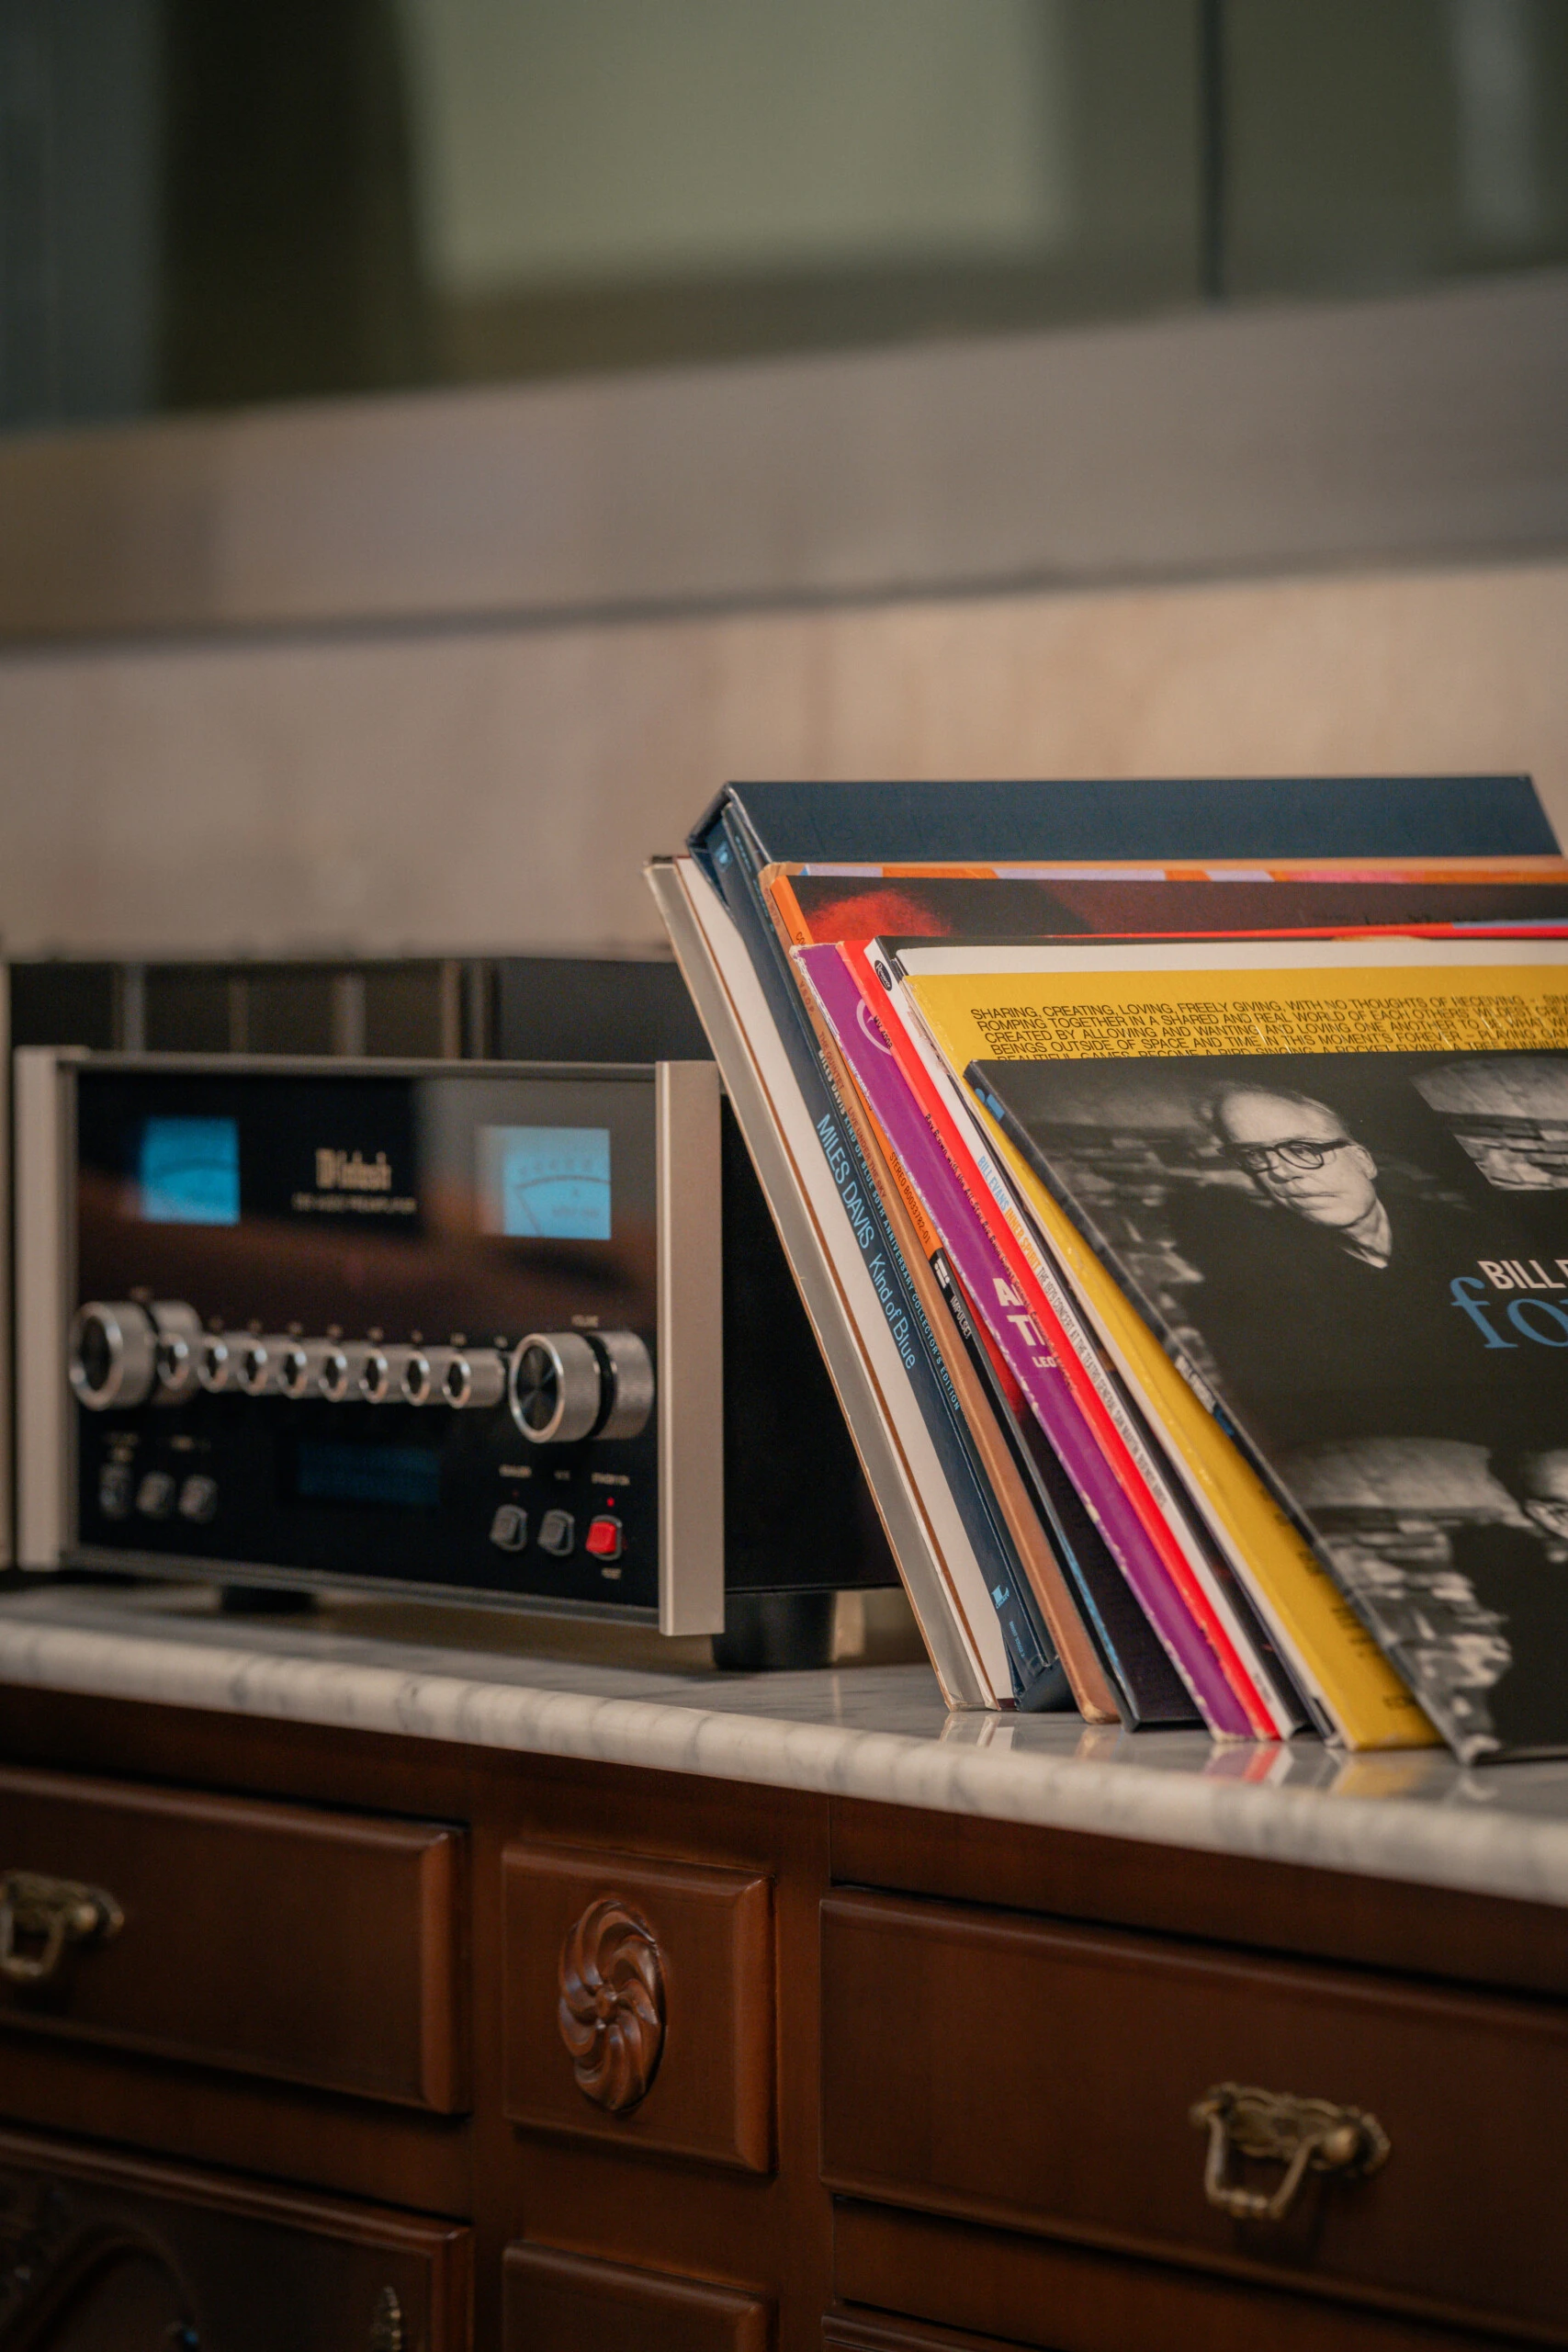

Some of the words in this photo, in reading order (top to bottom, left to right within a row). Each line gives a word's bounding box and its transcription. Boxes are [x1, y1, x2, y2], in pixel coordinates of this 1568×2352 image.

[970, 1007, 1042, 1019] SHARING,
[1043, 1005, 1118, 1016] CREATING,
[1118, 1003, 1178, 1015] LOVING,
[1177, 1002, 1228, 1013] FREELY
[1233, 1001, 1286, 1012] GIVING,
[1285, 1000, 1323, 1011] WITH
[1324, 999, 1348, 1010] NO
[1348, 998, 1427, 1010] THOUGHTS
[1429, 997, 1448, 1008] OF
[976, 1018, 1047, 1031] ROMPING
[1047, 1016, 1128, 1028] TOGETHER
[1129, 1015, 1145, 1026] IN
[1149, 1015, 1159, 1025] A
[1161, 1013, 1218, 1025] SHARED
[1224, 1013, 1252, 1023] AND
[1254, 1012, 1292, 1023] REAL
[1292, 1012, 1345, 1023] WORLD
[1348, 1011, 1367, 1021] OF
[1371, 1010, 1410, 1021] EACH
[985, 1030, 1053, 1043] CREATED
[1055, 1029, 1076, 1040] BY
[1083, 1027, 1158, 1039] ALLOWING
[1162, 1026, 1191, 1036] AND
[1193, 1024, 1260, 1036] WANTING
[1266, 1023, 1294, 1035] AND
[1296, 1023, 1351, 1034] LOVING
[1354, 1022, 1387, 1033] ONE
[1391, 1019, 1457, 1031] ANOTHER
[1458, 1019, 1479, 1029] TO
[990, 1042, 1048, 1055] BEINGS
[1051, 1040, 1114, 1052] OUTSIDE
[1117, 1039, 1136, 1049] OF
[1141, 1037, 1190, 1049] SPACE
[1193, 1036, 1222, 1047] AND
[1224, 1035, 1261, 1047] TIME
[1264, 1035, 1280, 1046] IN
[1281, 1035, 1315, 1046] THIS
[1317, 1033, 1393, 1045] MOMENT'S
[1396, 1030, 1462, 1043] FOREVER
[824, 1050, 844, 1090] QUINTET
[847, 1106, 859, 1126] LIVE
[855, 1128, 872, 1160] UNDER
[869, 1161, 879, 1179] THE
[875, 1179, 887, 1199] SKY
[888, 1151, 907, 1185] STEREO
[924, 1113, 936, 1130] Ray
[932, 1128, 949, 1154] Brown
[946, 1155, 959, 1173] with
[955, 1172, 966, 1187] the
[816, 1113, 851, 1184] MILES
[842, 1182, 875, 1250] DAVIS
[868, 1252, 893, 1301] Kind
[885, 1298, 901, 1323] of
[894, 1319, 916, 1370] Blue
[817, 1050, 832, 1081] MILES
[829, 1084, 845, 1115] DAVIS
[841, 1115, 855, 1142] KIND
[859, 1160, 874, 1188] BLUE
[882, 1218, 914, 1290] ANNIVERSARY
[939, 1366, 961, 1410] EDITION
[976, 1155, 993, 1179] BILL
[988, 1176, 1010, 1211] EVANS
[1004, 1206, 1025, 1239] INNER
[1020, 1237, 1043, 1271] SPIRIT
[1035, 1266, 1049, 1284] THE
[1052, 1296, 1077, 1333] CONCERT
[1477, 1260, 1567, 1289] BILL
[950, 1295, 973, 1340] IMPULSE!
[1450, 1276, 1568, 1349] fo
